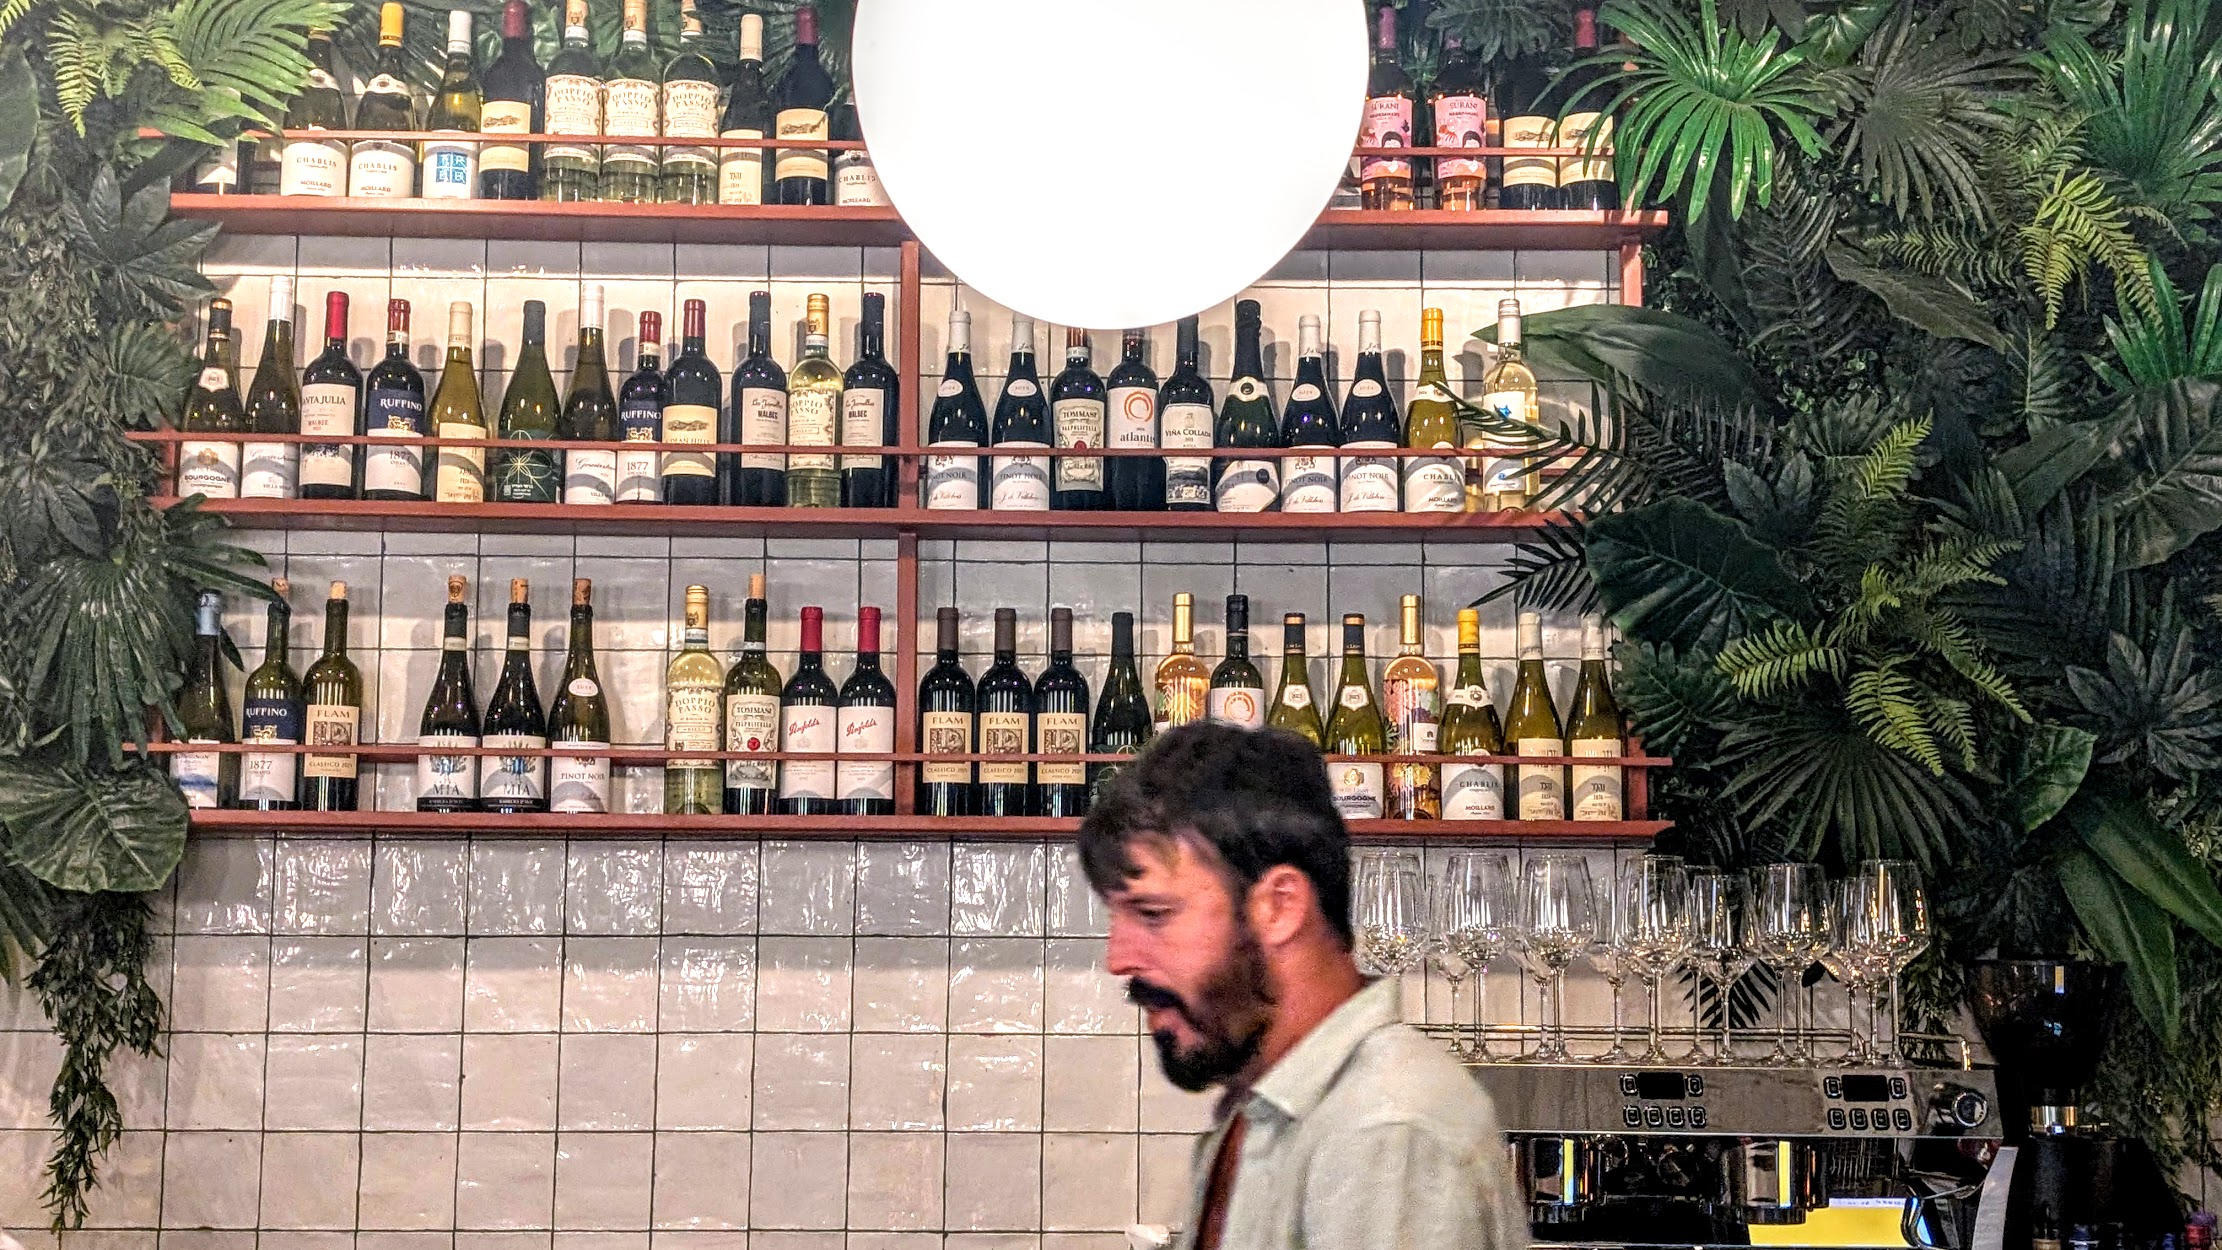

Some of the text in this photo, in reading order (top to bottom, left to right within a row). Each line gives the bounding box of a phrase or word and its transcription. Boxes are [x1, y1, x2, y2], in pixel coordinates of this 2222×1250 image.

[554, 87, 594, 101] DOPPIO
[612, 91, 652, 104] DOPPIO
[672, 92, 712, 105] DOPPIO
[557, 96, 590, 106] PASSO
[615, 99, 648, 109] PASSO
[675, 100, 708, 111] PASSO
[296, 157, 337, 168] CHABLIS
[358, 163, 398, 172] CHABLIS
[838, 174, 876, 183] CHABLIS
[320, 395, 346, 405] JULIA
[380, 398, 423, 412] RUFFINO
[620, 409, 662, 422] RUFFINO
[1062, 410, 1098, 419] TOMMASI
[389, 450, 411, 461] 1877
[627, 461, 649, 471] 1877
[946, 472, 967, 480] NOIR
[1368, 472, 1389, 480] NOIR
[1423, 473, 1462, 481] CHABLI
[675, 697, 716, 708] DOPPIO
[245, 707, 288, 719] RUFFINO
[316, 709, 350, 719] FLAM
[678, 704, 712, 714] PASSO
[736, 706, 773, 715] TOMMASI
[932, 716, 964, 725] FLAM
[989, 717, 1020, 726] FLAM
[1046, 717, 1078, 726] FLAM
[788, 717, 820, 737] Penfolds
[846, 718, 878, 737] Penfolds
[249, 760, 273, 770] 1877
[308, 760, 340, 769] CLASSICO
[560, 772, 586, 780] PINOT
[1459, 780, 1499, 788] CHABLIS
